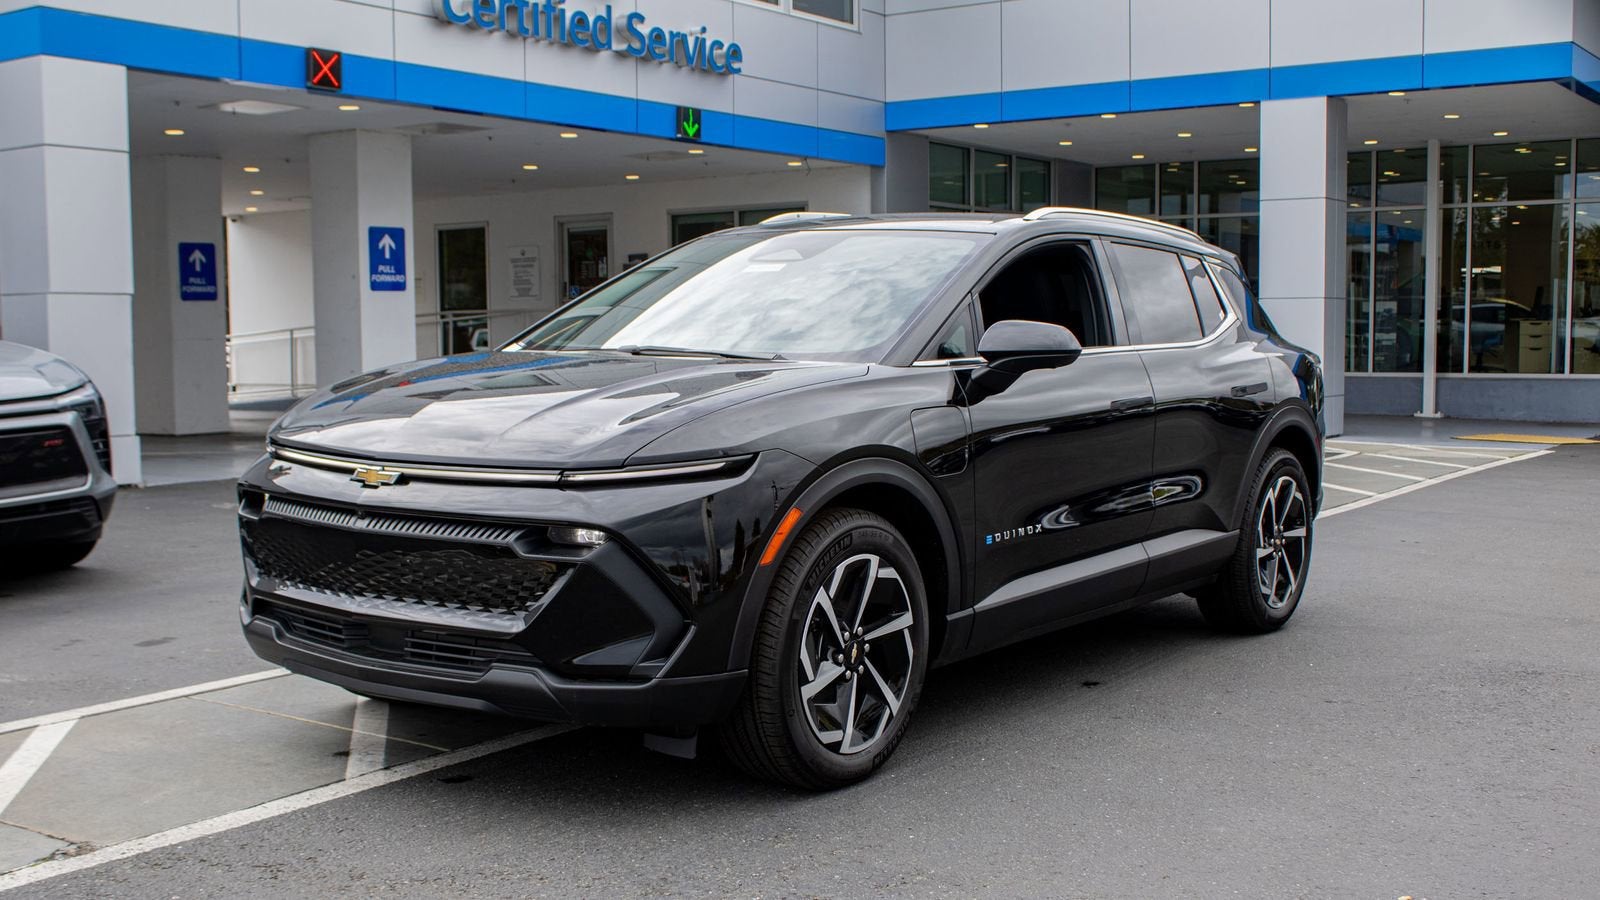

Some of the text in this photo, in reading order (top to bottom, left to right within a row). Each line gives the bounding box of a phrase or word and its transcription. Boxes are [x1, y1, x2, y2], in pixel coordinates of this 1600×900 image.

[626, 12, 743, 75] Service
[378, 265, 396, 273] PULL
[371, 274, 405, 283] FORWARD
[985, 523, 1042, 545] EQUINOX
